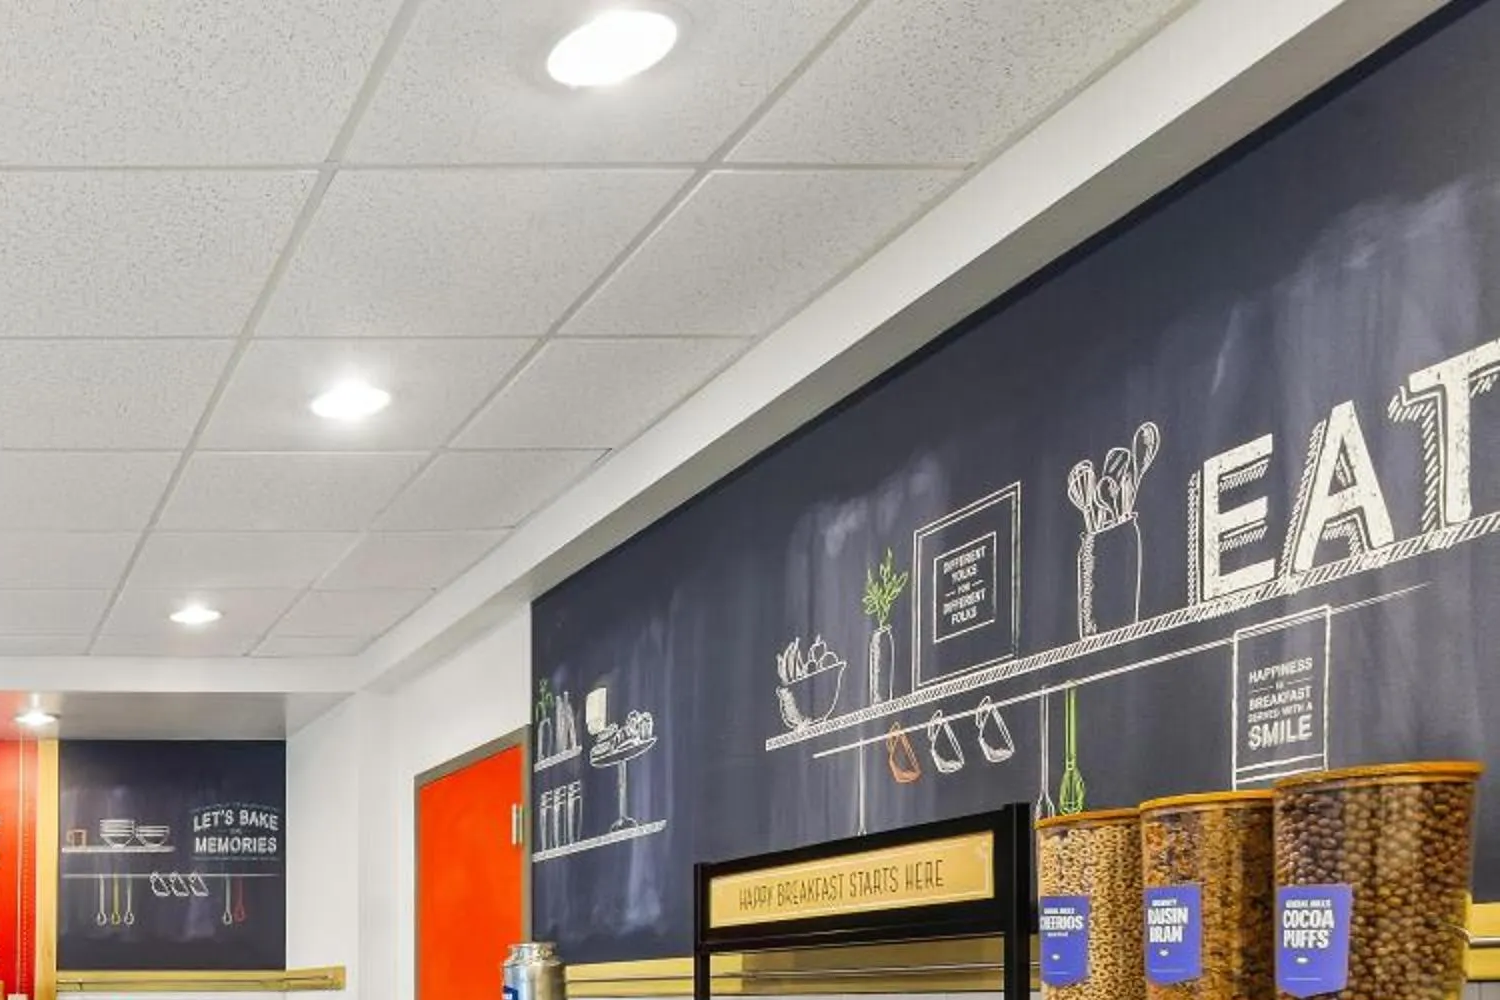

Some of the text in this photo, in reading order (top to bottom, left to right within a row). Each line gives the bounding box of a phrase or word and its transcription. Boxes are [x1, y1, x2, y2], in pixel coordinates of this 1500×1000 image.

[1187, 337, 1500, 606] EAT
[943, 545, 987, 575] DIFFERENT
[943, 588, 987, 616] DIFFERENT
[951, 605, 978, 625] FOLKS
[1248, 657, 1313, 684] HAPPINESS
[1248, 685, 1313, 711] BREAKFAST
[1281, 702, 1304, 716] WITH
[1306, 700, 1313, 711] A
[1248, 713, 1313, 750] SMILE
[193, 808, 279, 833] LET'S BAKE
[194, 836, 278, 854] MEMORIES
[739, 859, 945, 911] HAPPY BREAKFAST STARTS HERE
[1283, 909, 1335, 929] COCOA
[1283, 929, 1329, 949] PUFFS
